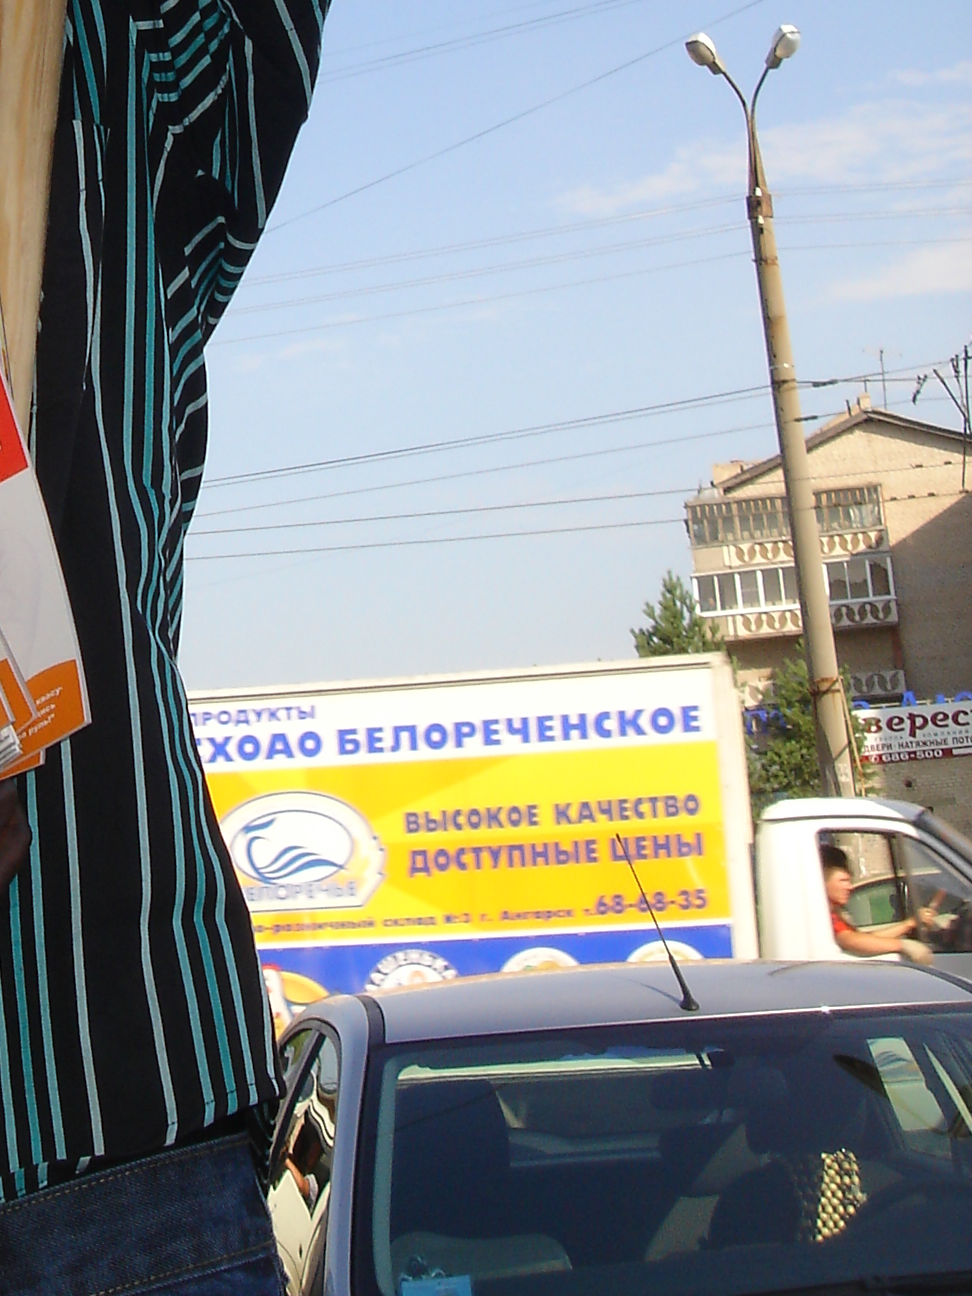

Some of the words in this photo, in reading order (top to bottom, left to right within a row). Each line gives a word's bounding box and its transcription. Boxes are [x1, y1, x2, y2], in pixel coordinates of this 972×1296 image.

[196, 730, 323, 764] ХОАО
[336, 704, 702, 757] БЕЛОРЕЧЕНСКОЕ
[862, 708, 972, 738] верес
[952, 735, 972, 745] ПОТ
[404, 802, 540, 835] ВЫСОКОЕ
[554, 793, 701, 825] КАЧЕСТВО
[409, 837, 599, 877] ДОСТУПНЫЕ
[610, 832, 704, 866] ЦЕНЫ
[500, 908, 575, 925] Ангарск
